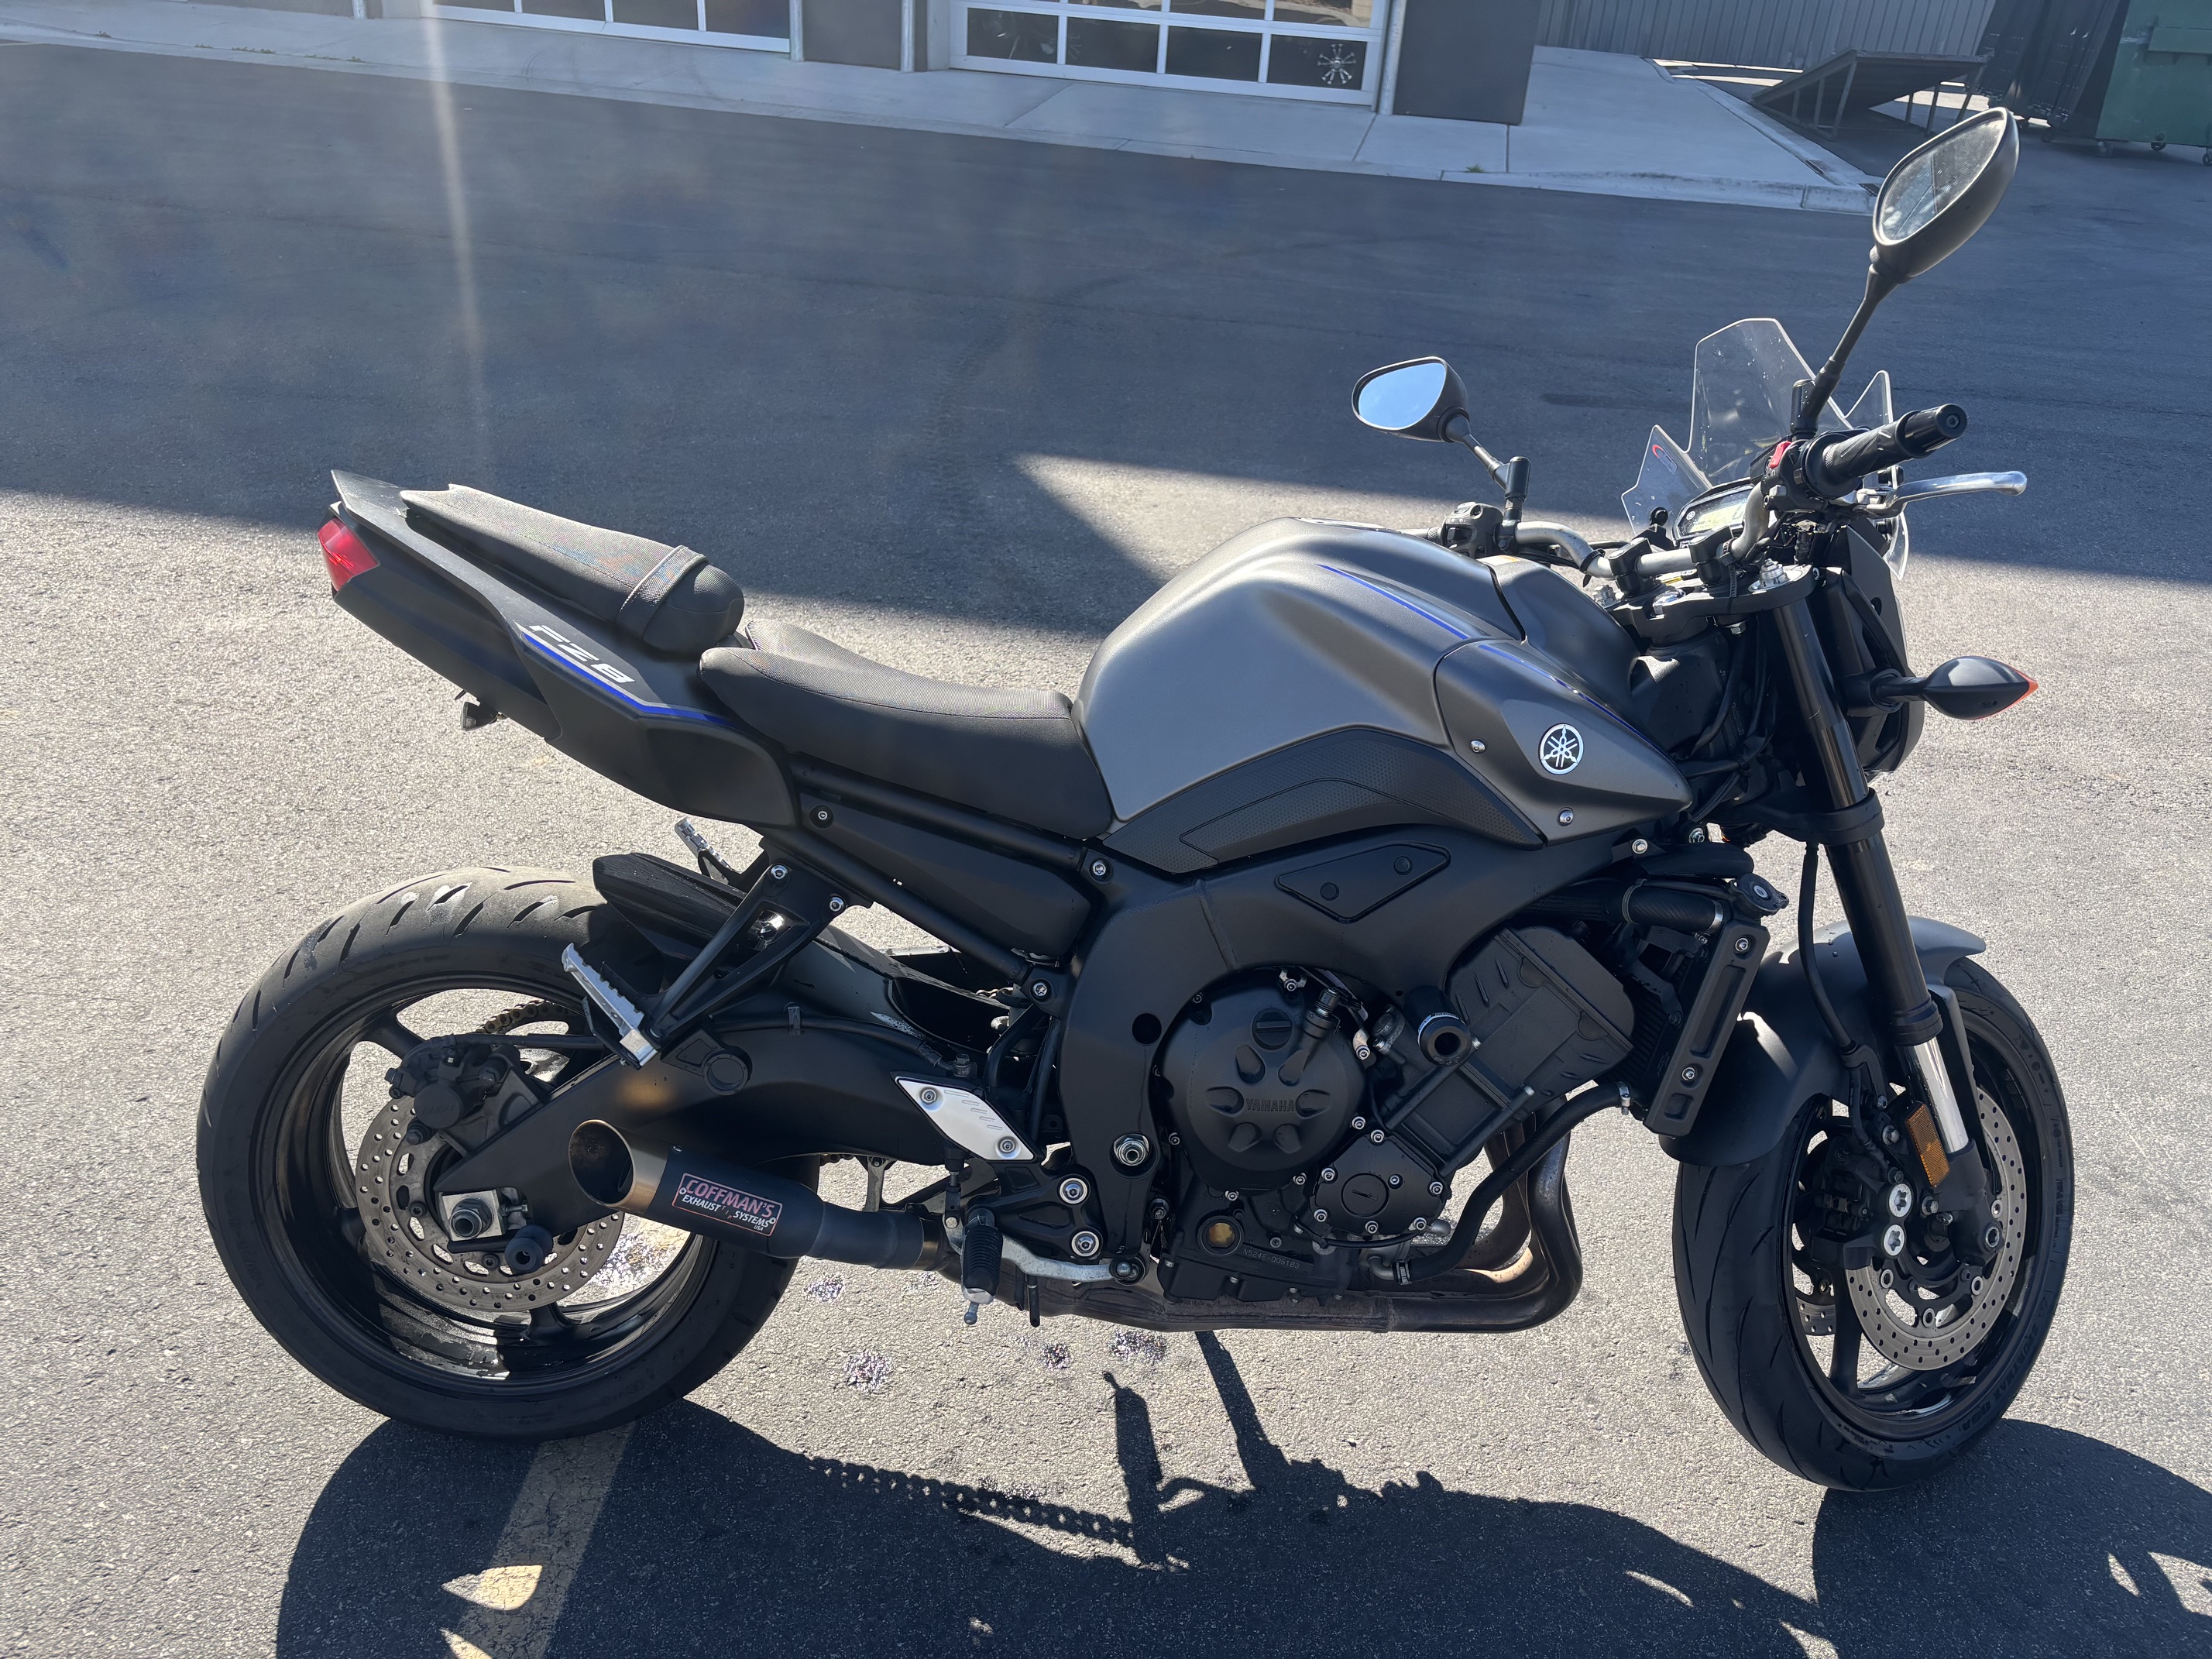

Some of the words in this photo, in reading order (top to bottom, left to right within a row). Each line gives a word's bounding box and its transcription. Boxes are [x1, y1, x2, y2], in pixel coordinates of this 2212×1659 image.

[528, 624, 635, 683] FZ8
[1245, 1097, 1294, 1112] YAMAHA
[682, 1194, 722, 1212] EXHAUST
[733, 1211, 769, 1228] SYSTEMS
[685, 1180, 775, 1218] COFFMAN'S
